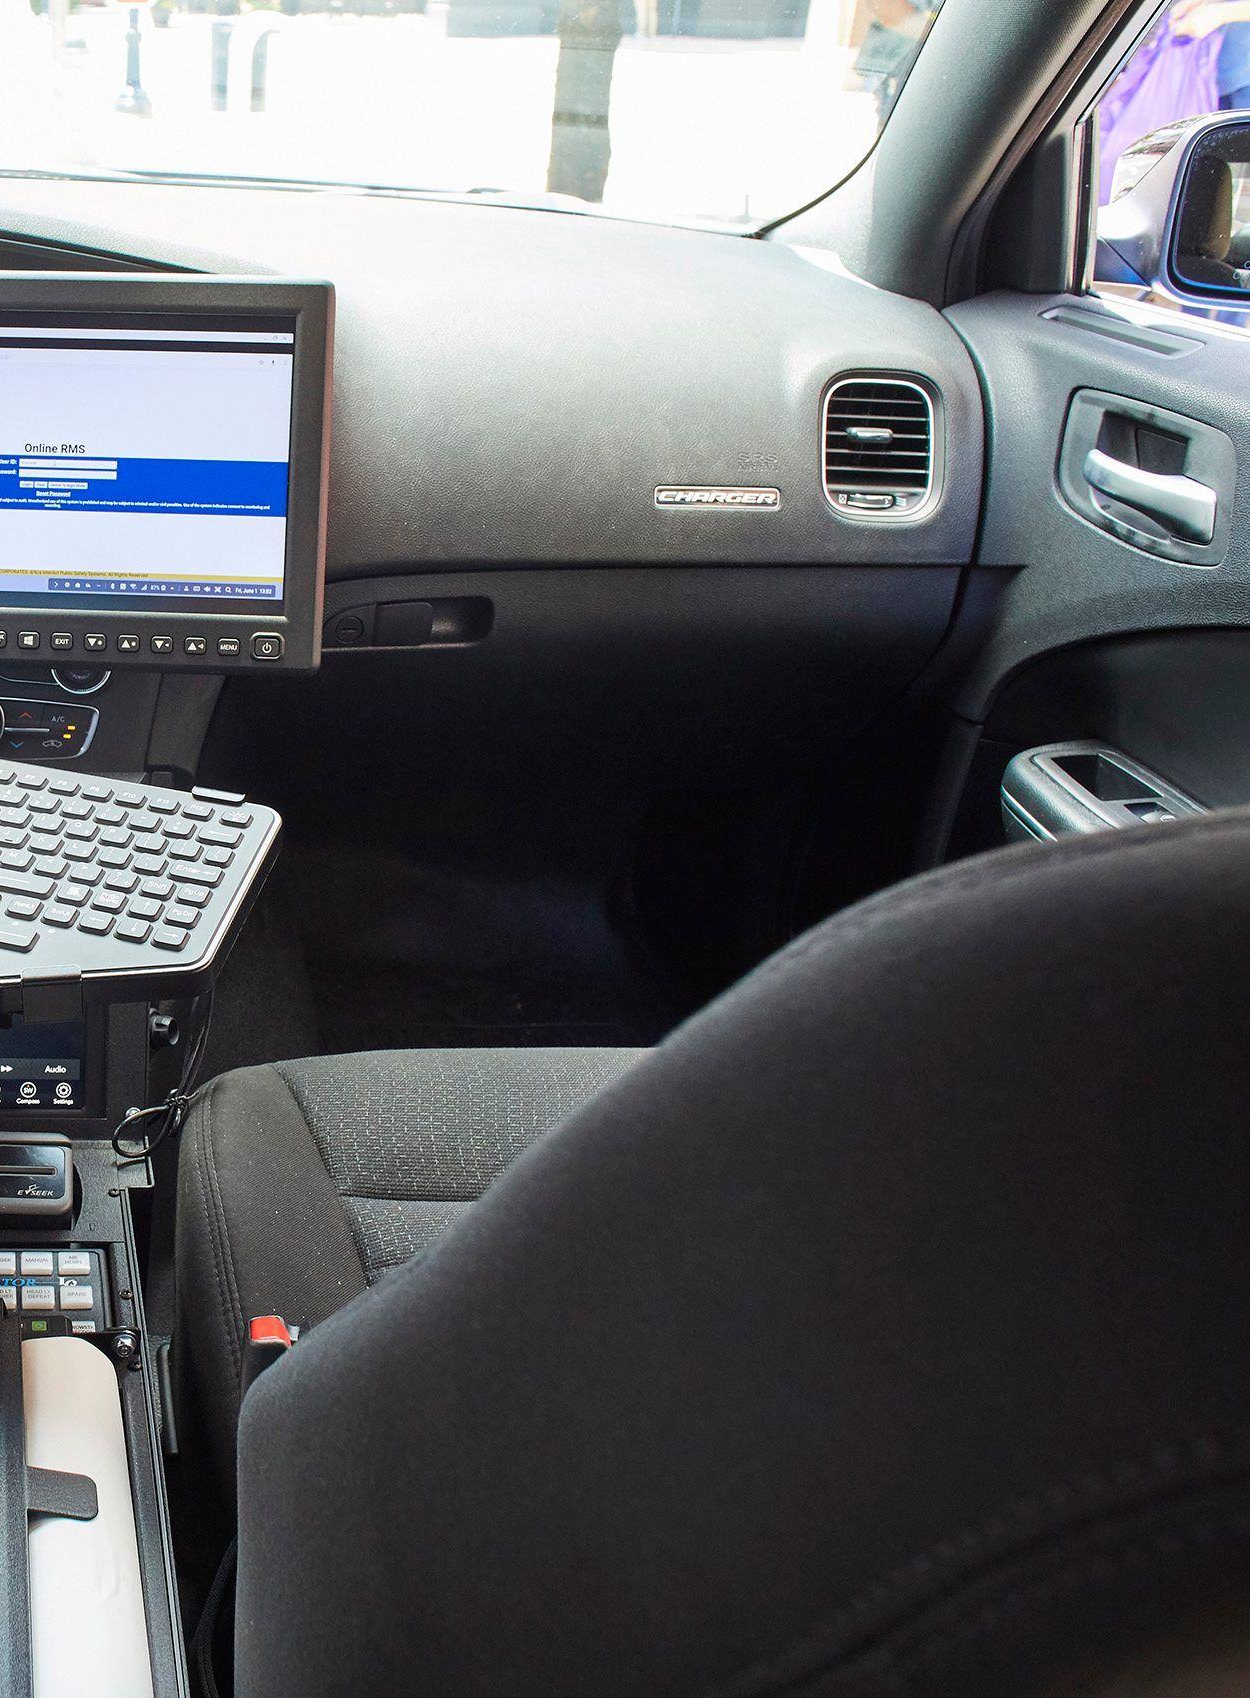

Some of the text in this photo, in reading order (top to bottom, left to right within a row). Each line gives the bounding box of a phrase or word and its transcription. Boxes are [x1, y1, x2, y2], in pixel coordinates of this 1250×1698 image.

[24, 443, 86, 454] Online RMS
[657, 490, 777, 504] CHARGER
[51, 715, 65, 723] A/C
[175, 864, 201, 875] Enter
[147, 880, 168, 891] Shift
[44, 1065, 67, 1074] Audio
[53, 1098, 74, 1106] Settings
